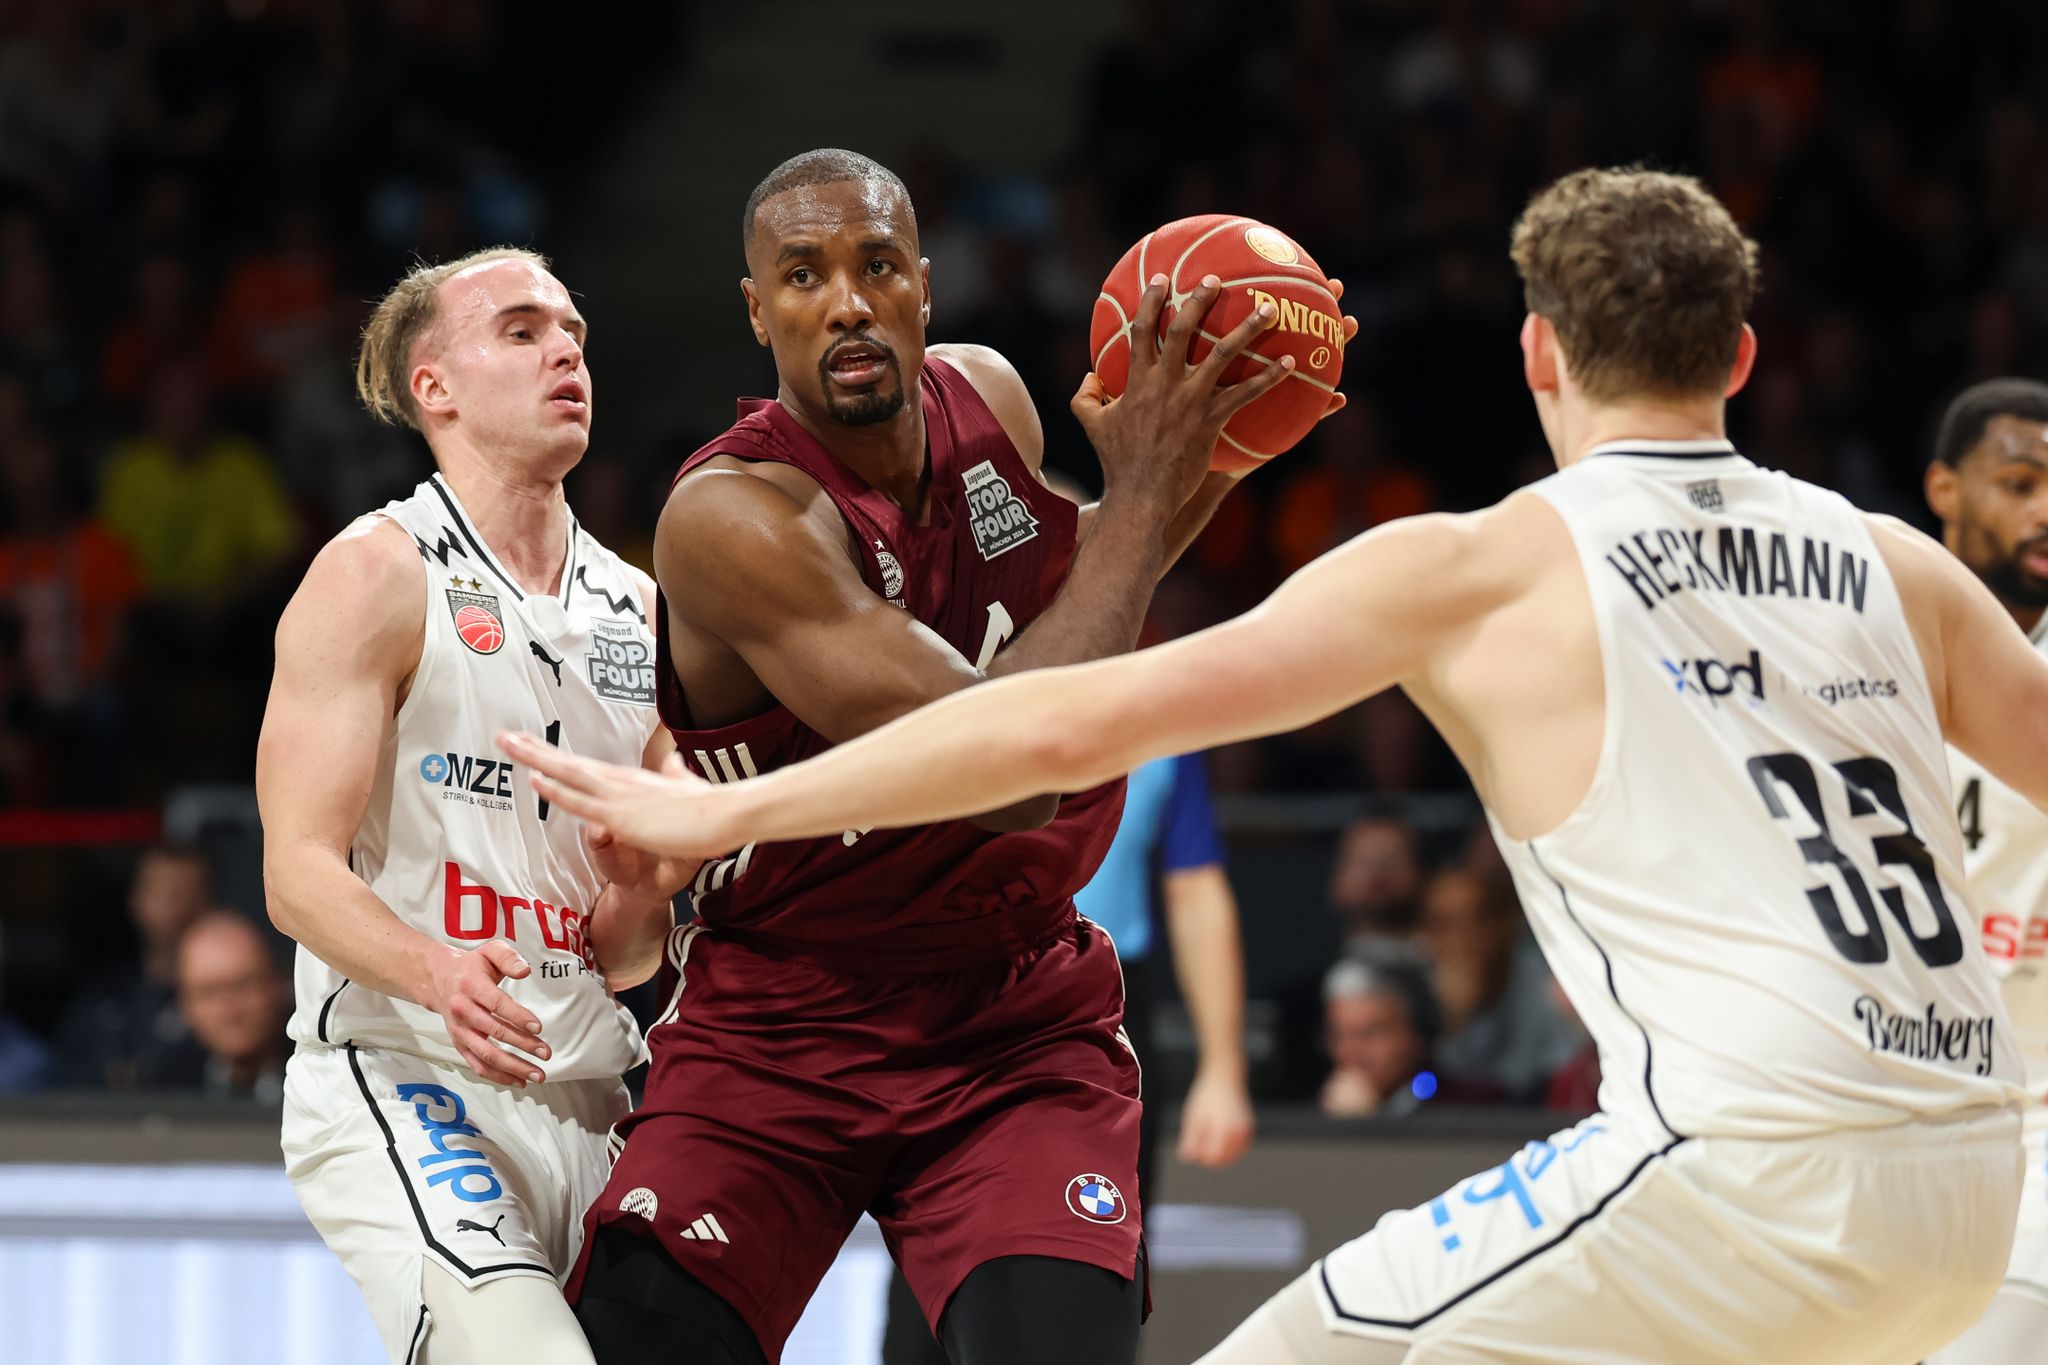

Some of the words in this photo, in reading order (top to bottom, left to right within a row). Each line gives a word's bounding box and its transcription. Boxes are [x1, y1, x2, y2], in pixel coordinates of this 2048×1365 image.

[1255, 290, 1345, 352] PALDING
[969, 482, 1007, 516] TOP
[974, 503, 1028, 544] FOUR
[1012, 528, 1026, 540] 2024
[1605, 526, 1868, 615] HECKMANN
[449, 591, 498, 603] BAMBERG
[596, 638, 646, 665] TOP
[591, 661, 656, 690] FOUR
[603, 686, 633, 699] MÜNCHEN
[633, 691, 650, 700] 2024
[1804, 677, 1898, 706] gistics
[444, 752, 513, 798] MZE
[469, 796, 475, 805] &
[1747, 750, 1964, 968] 33
[540, 960, 571, 979] für
[1076, 1176, 1120, 1199] BMW
